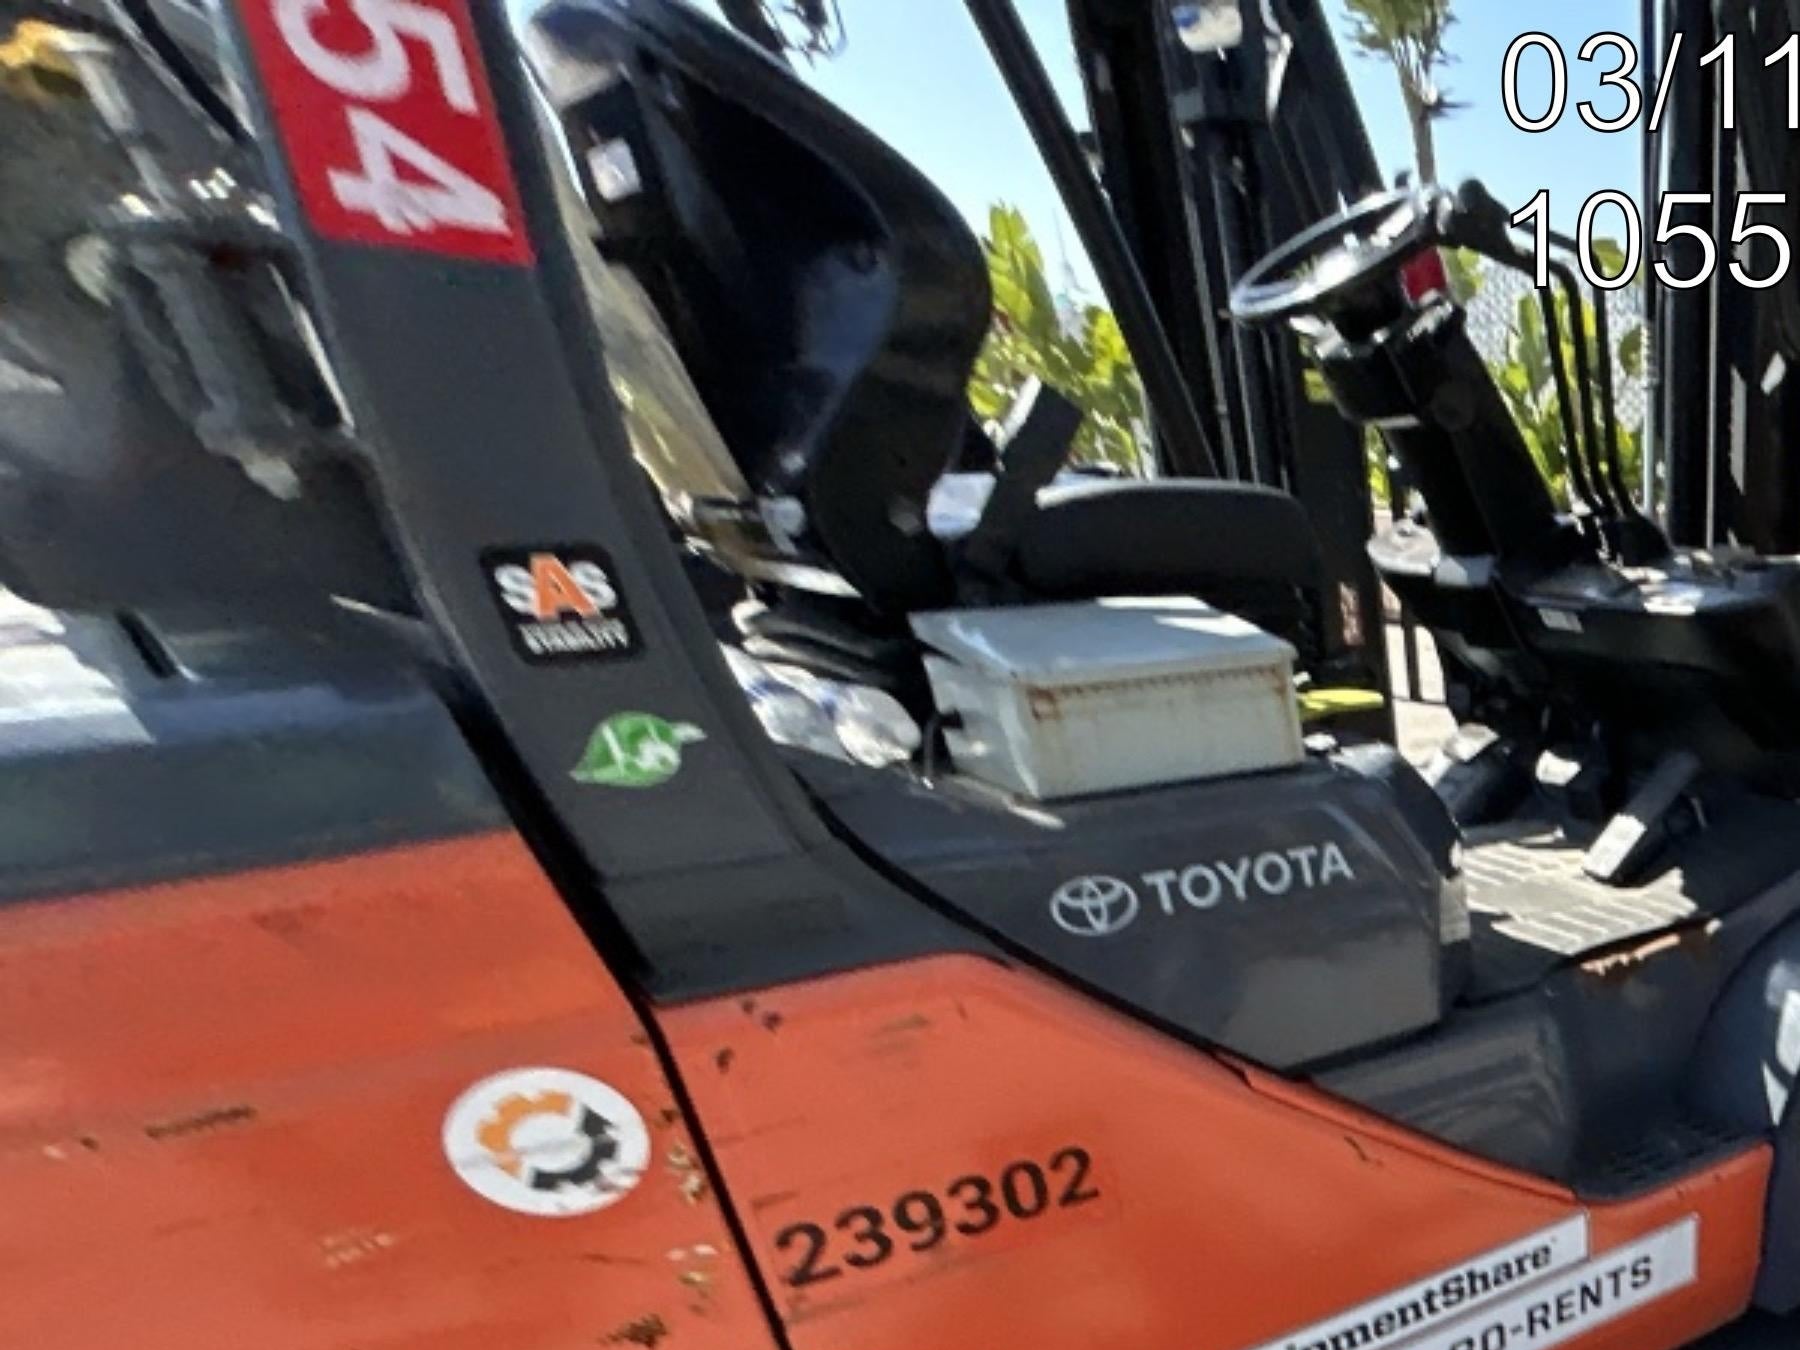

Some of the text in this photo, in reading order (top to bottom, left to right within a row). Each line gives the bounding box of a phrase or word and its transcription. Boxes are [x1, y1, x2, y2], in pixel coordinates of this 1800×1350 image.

[494, 552, 618, 623] SAS
[1142, 840, 1355, 916] TOYOTA
[774, 1145, 1101, 1288] 239302
